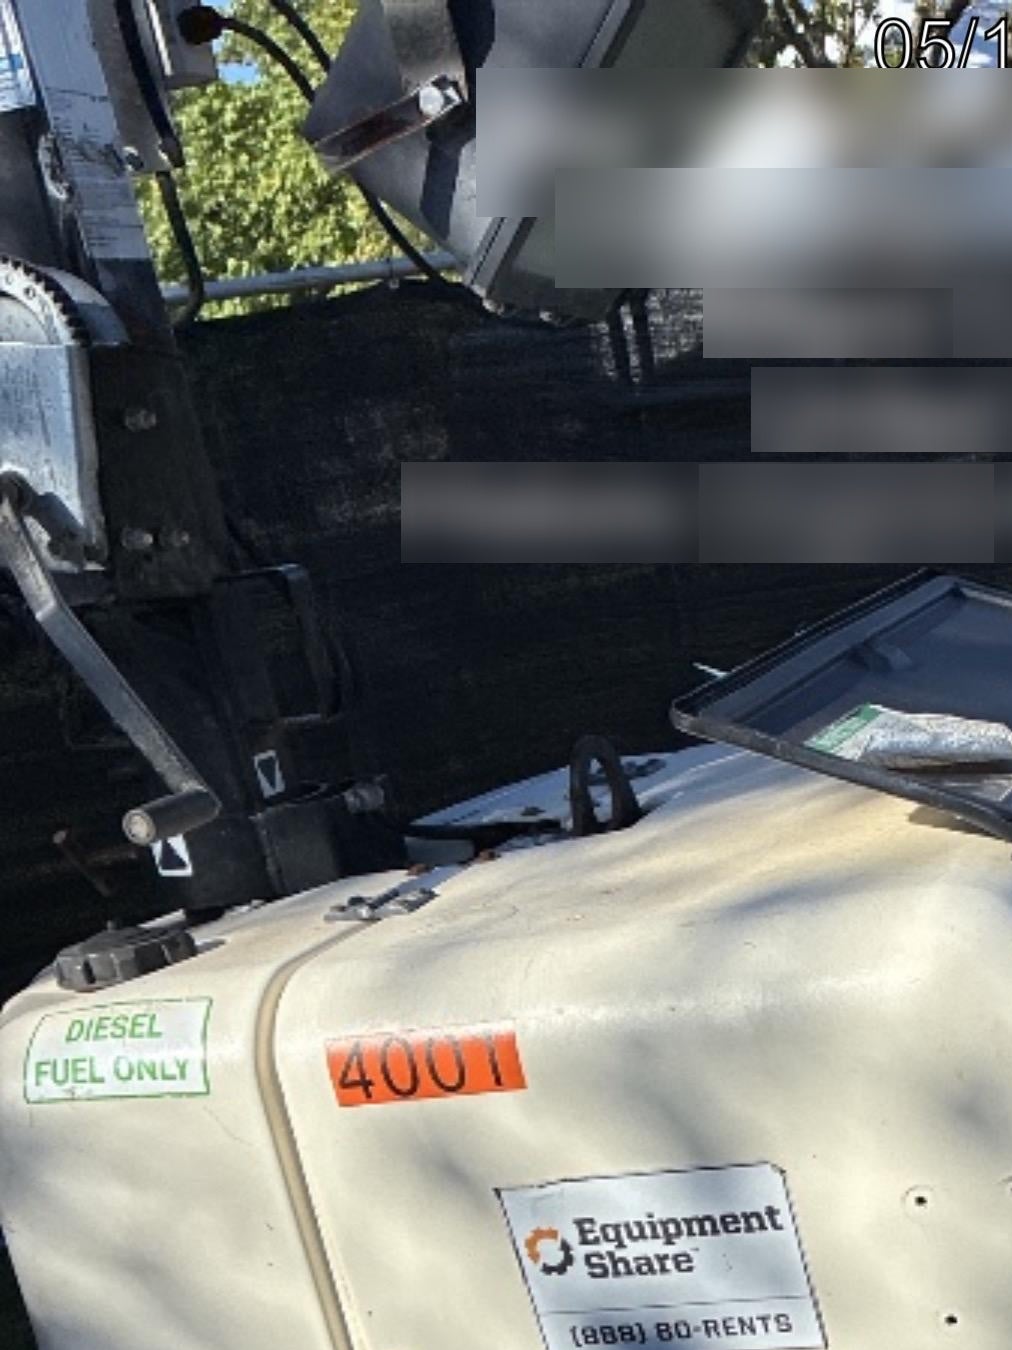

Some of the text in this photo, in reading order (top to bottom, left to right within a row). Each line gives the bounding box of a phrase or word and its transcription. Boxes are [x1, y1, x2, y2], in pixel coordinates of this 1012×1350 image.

[65, 1013, 163, 1043] DIESEL
[34, 1057, 189, 1087] FUEL ONLY
[338, 1032, 509, 1100] 4001
[574, 1205, 784, 1247] Equipment
[585, 1249, 695, 1279] Share
